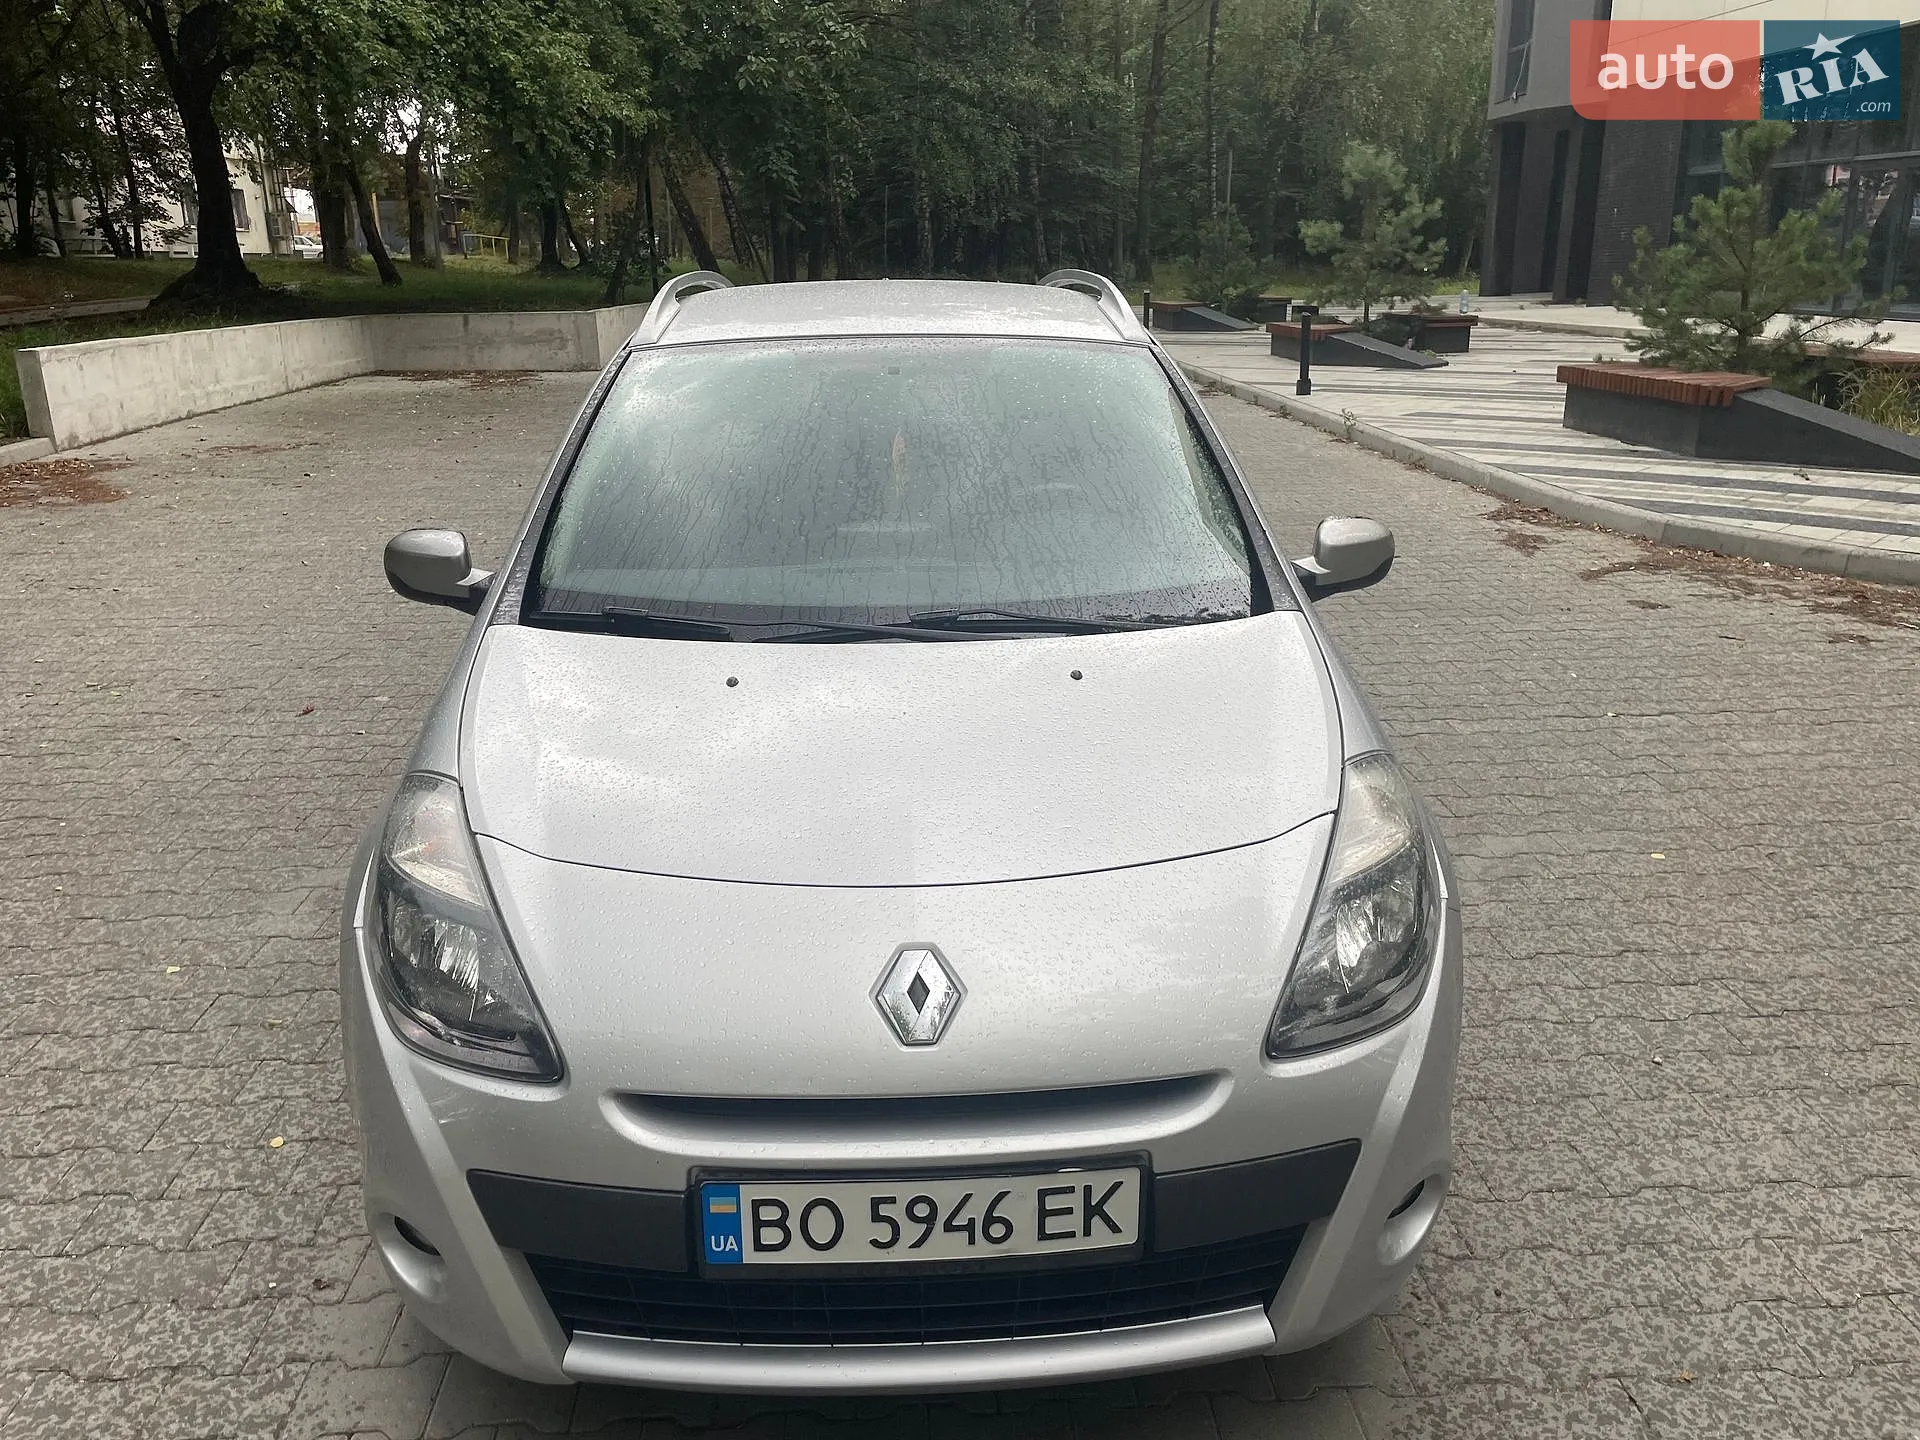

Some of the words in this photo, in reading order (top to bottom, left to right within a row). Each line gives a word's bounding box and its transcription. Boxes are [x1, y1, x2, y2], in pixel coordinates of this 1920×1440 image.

[751, 1197, 845, 1252] BO
[868, 1190, 1014, 1250] 5946
[1036, 1180, 1125, 1242] EK
[710, 1235, 739, 1252] UA
